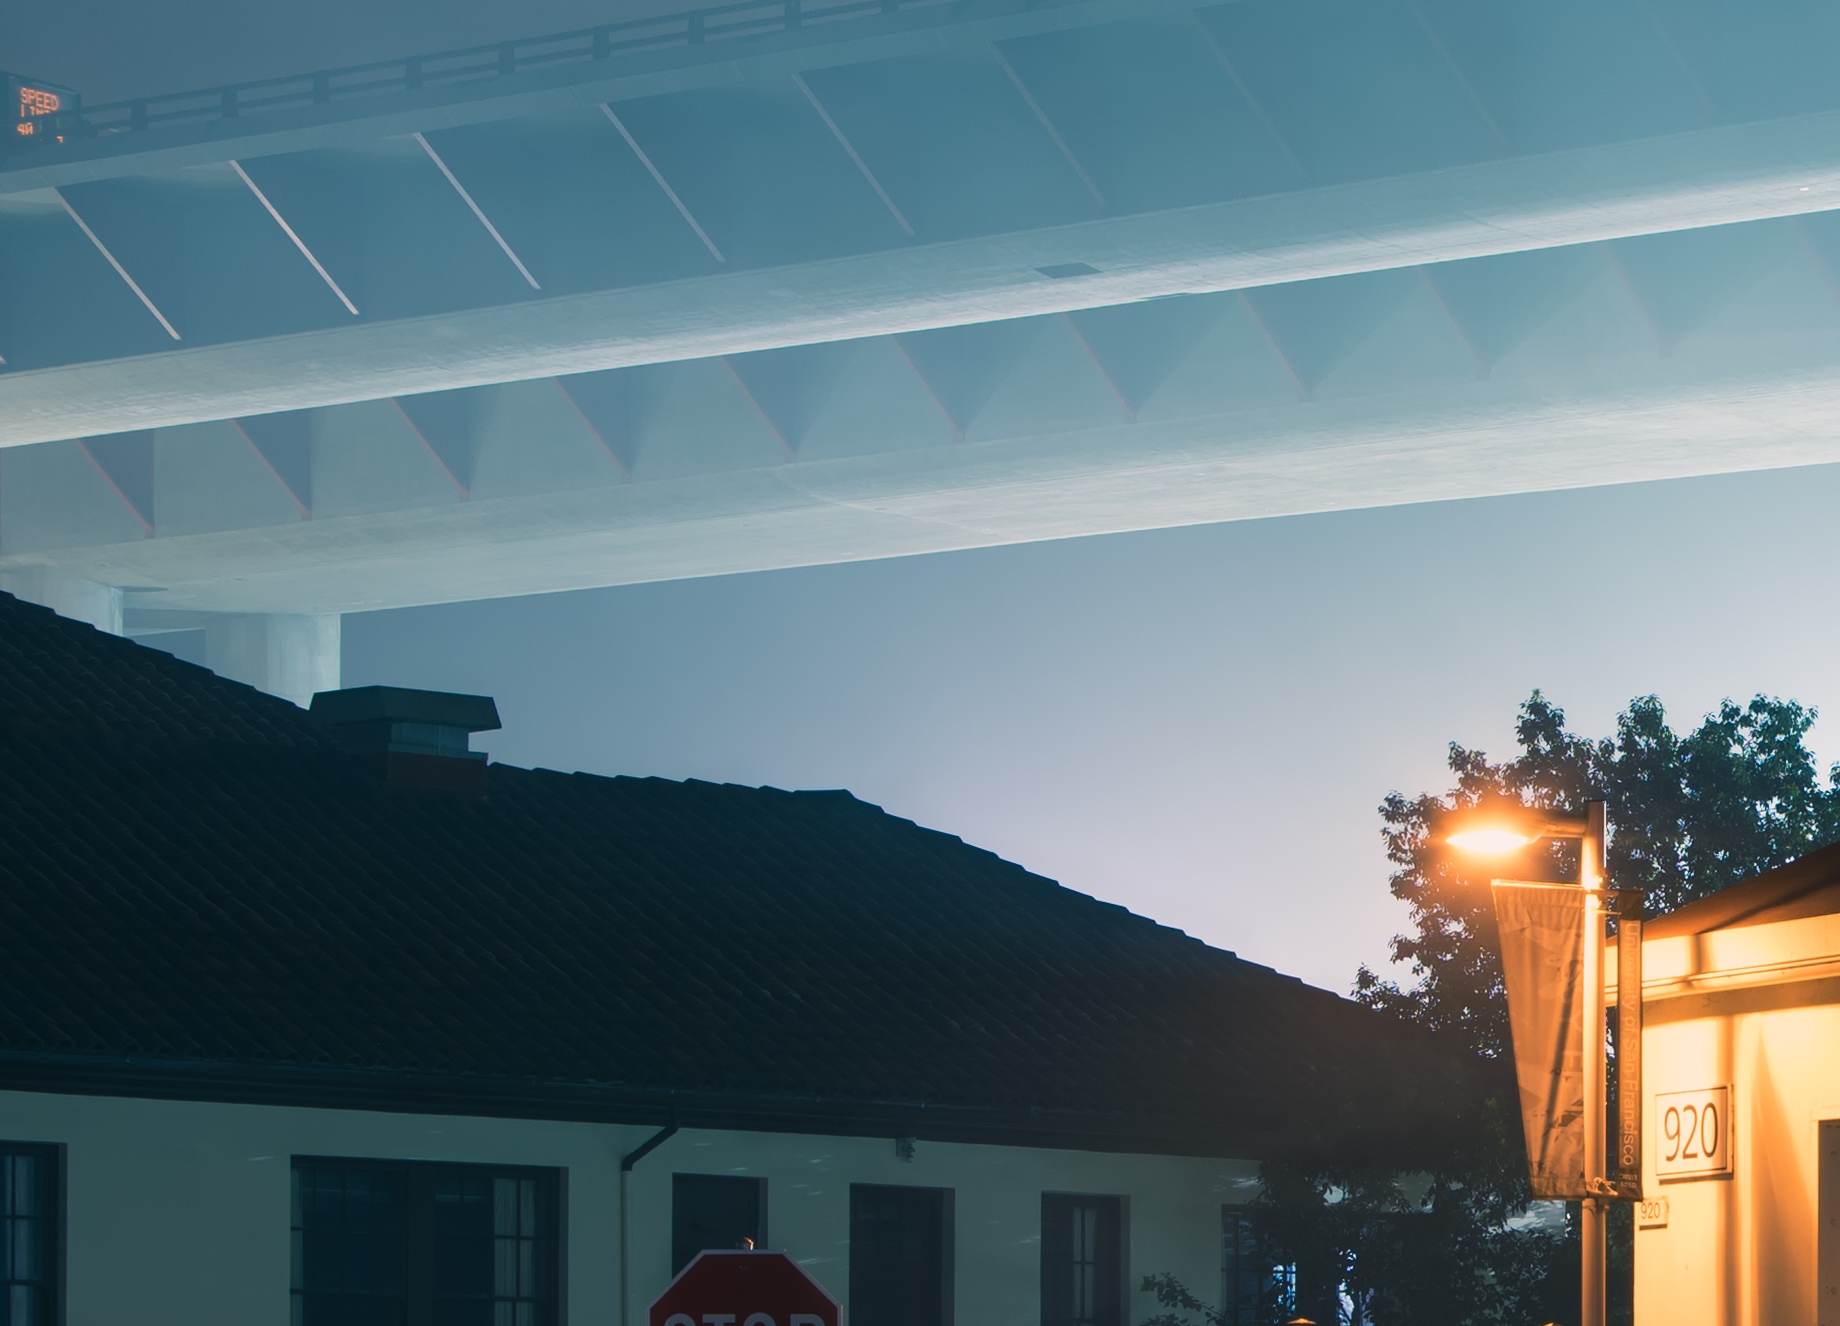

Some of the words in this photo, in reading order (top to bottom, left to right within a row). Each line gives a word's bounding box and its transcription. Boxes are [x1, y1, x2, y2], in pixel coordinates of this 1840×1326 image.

[1622, 922, 1640, 1012] University
[1623, 1016, 1638, 1034] of
[1623, 1039, 1638, 1073] San
[1622, 1080, 1639, 1166] Francisco
[1664, 1102, 1719, 1162] 920
[1640, 1202, 1661, 1219] 920
